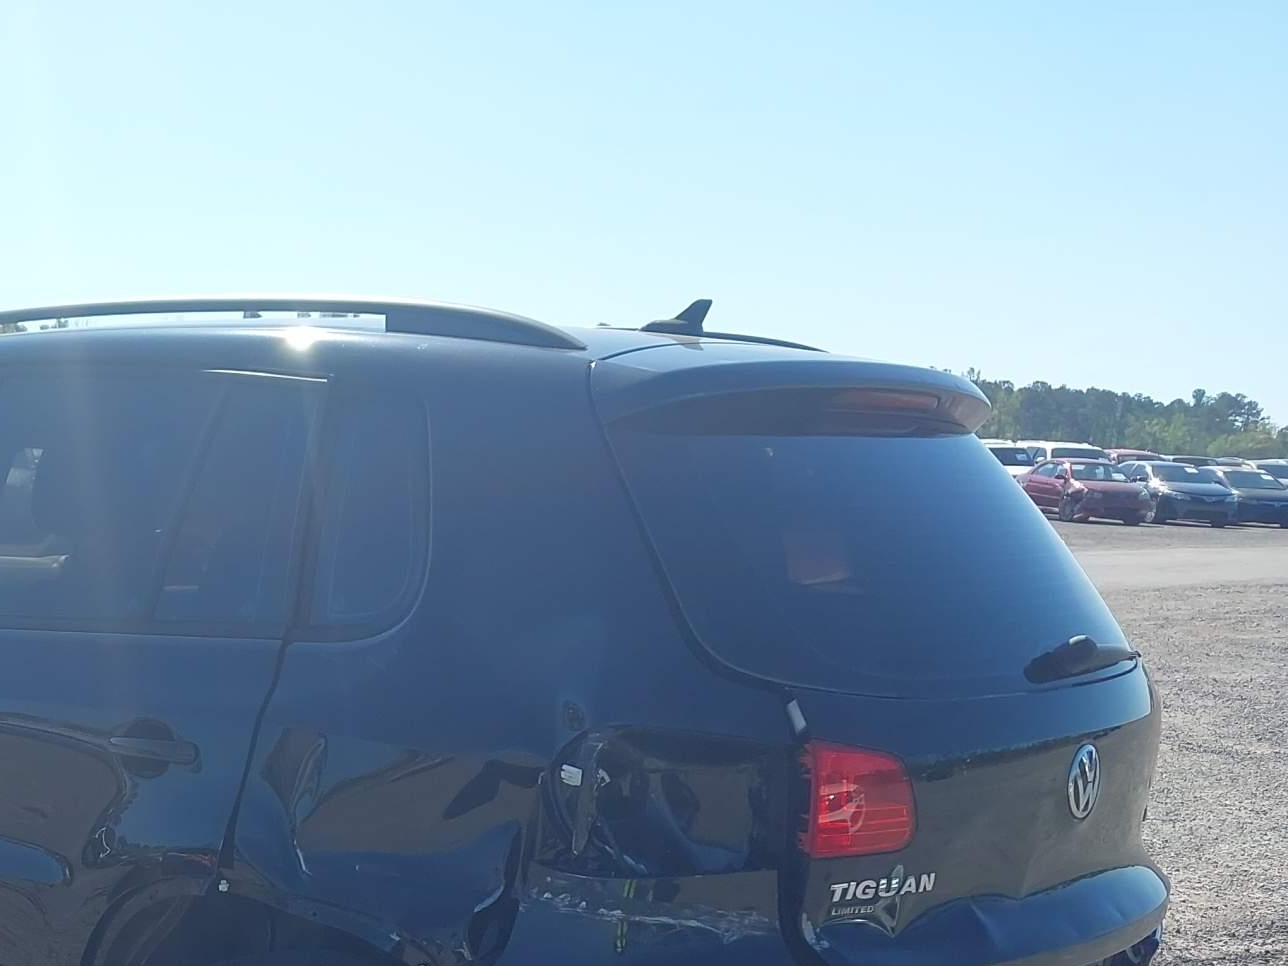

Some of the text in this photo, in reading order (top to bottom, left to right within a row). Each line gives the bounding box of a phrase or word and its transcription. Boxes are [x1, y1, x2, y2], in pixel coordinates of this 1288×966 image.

[1068, 744, 1101, 819] VW
[829, 872, 936, 903] TIGUAN
[831, 904, 875, 916] LIMITED
